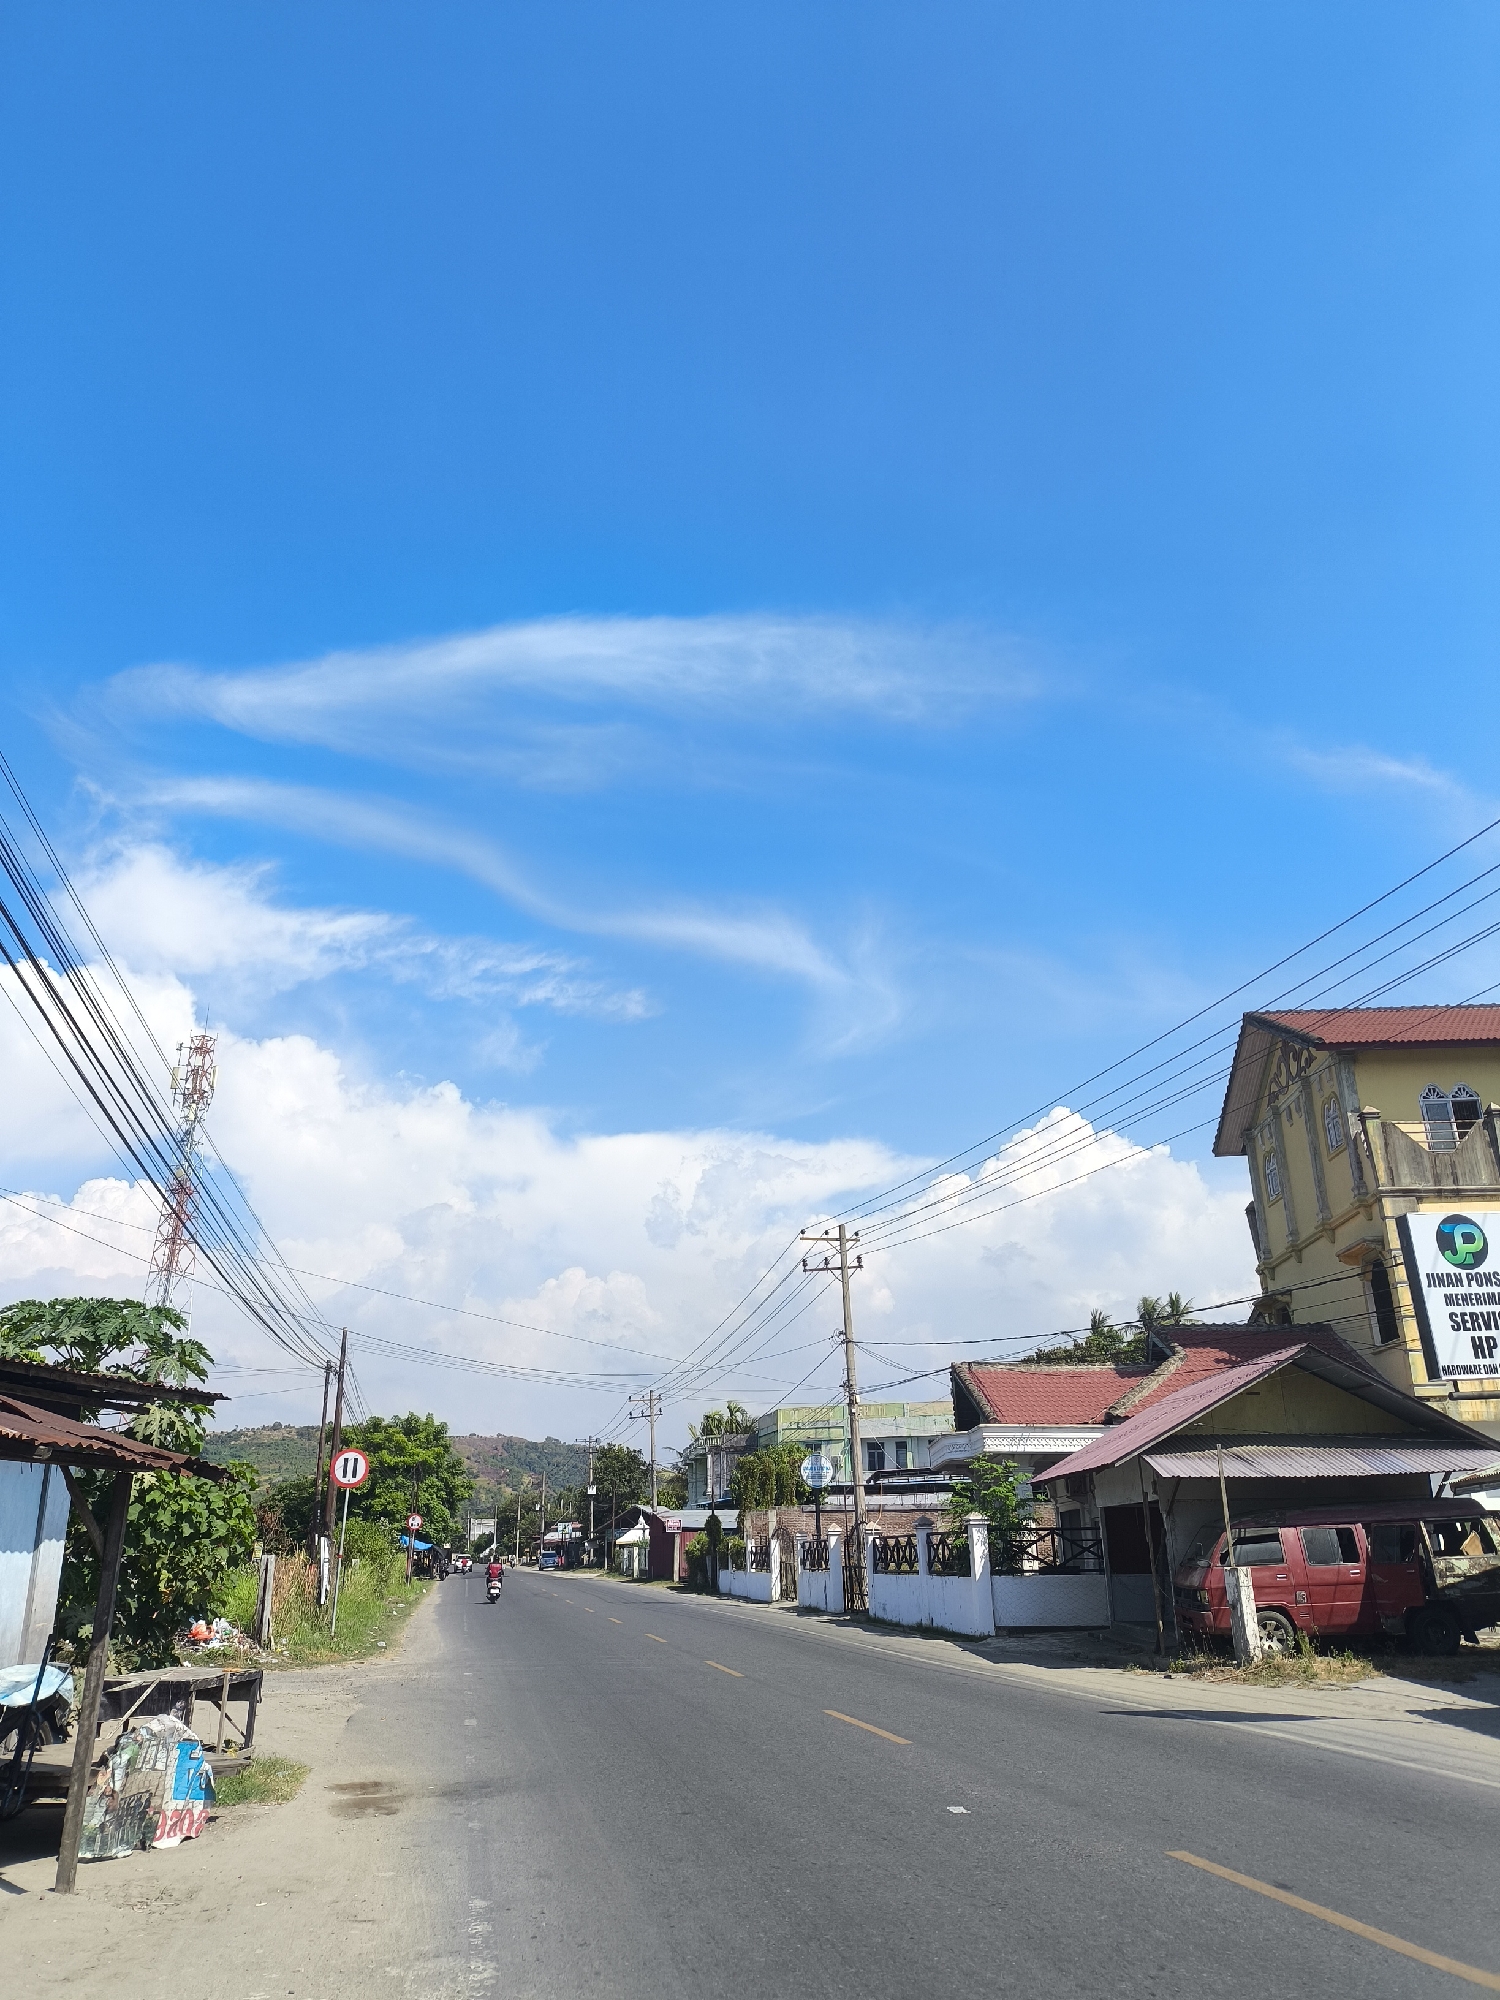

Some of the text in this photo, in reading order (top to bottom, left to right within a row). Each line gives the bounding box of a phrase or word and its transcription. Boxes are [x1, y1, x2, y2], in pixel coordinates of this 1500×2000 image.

[1425, 1272, 1464, 1288] JINAN
[1470, 1336, 1498, 1360] HP
[1441, 1363, 1499, 1376] HARDWARE DAN
